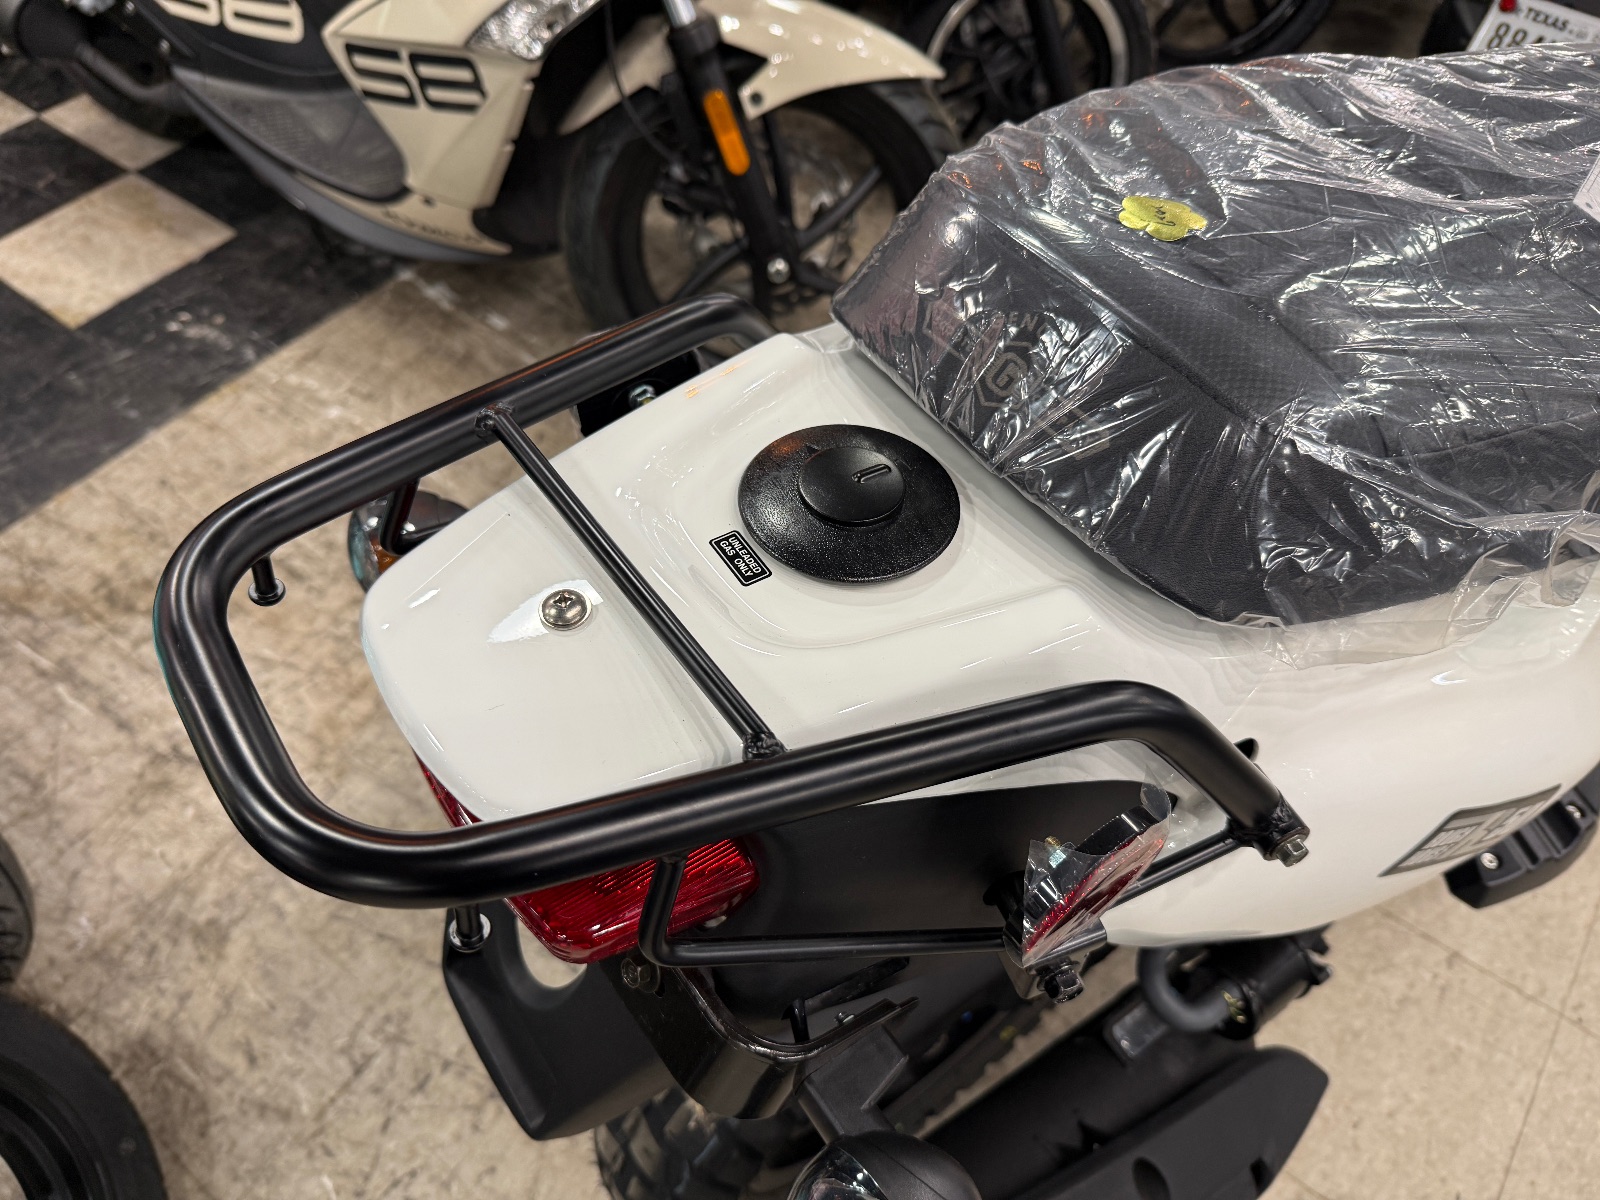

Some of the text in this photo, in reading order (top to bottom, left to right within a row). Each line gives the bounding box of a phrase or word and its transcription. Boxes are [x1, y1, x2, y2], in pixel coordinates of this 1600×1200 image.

[1525, 7, 1569, 31] TEXAS
[720, 541, 754, 576] GAS ONLY
[729, 537, 761, 573] UNLEADED
